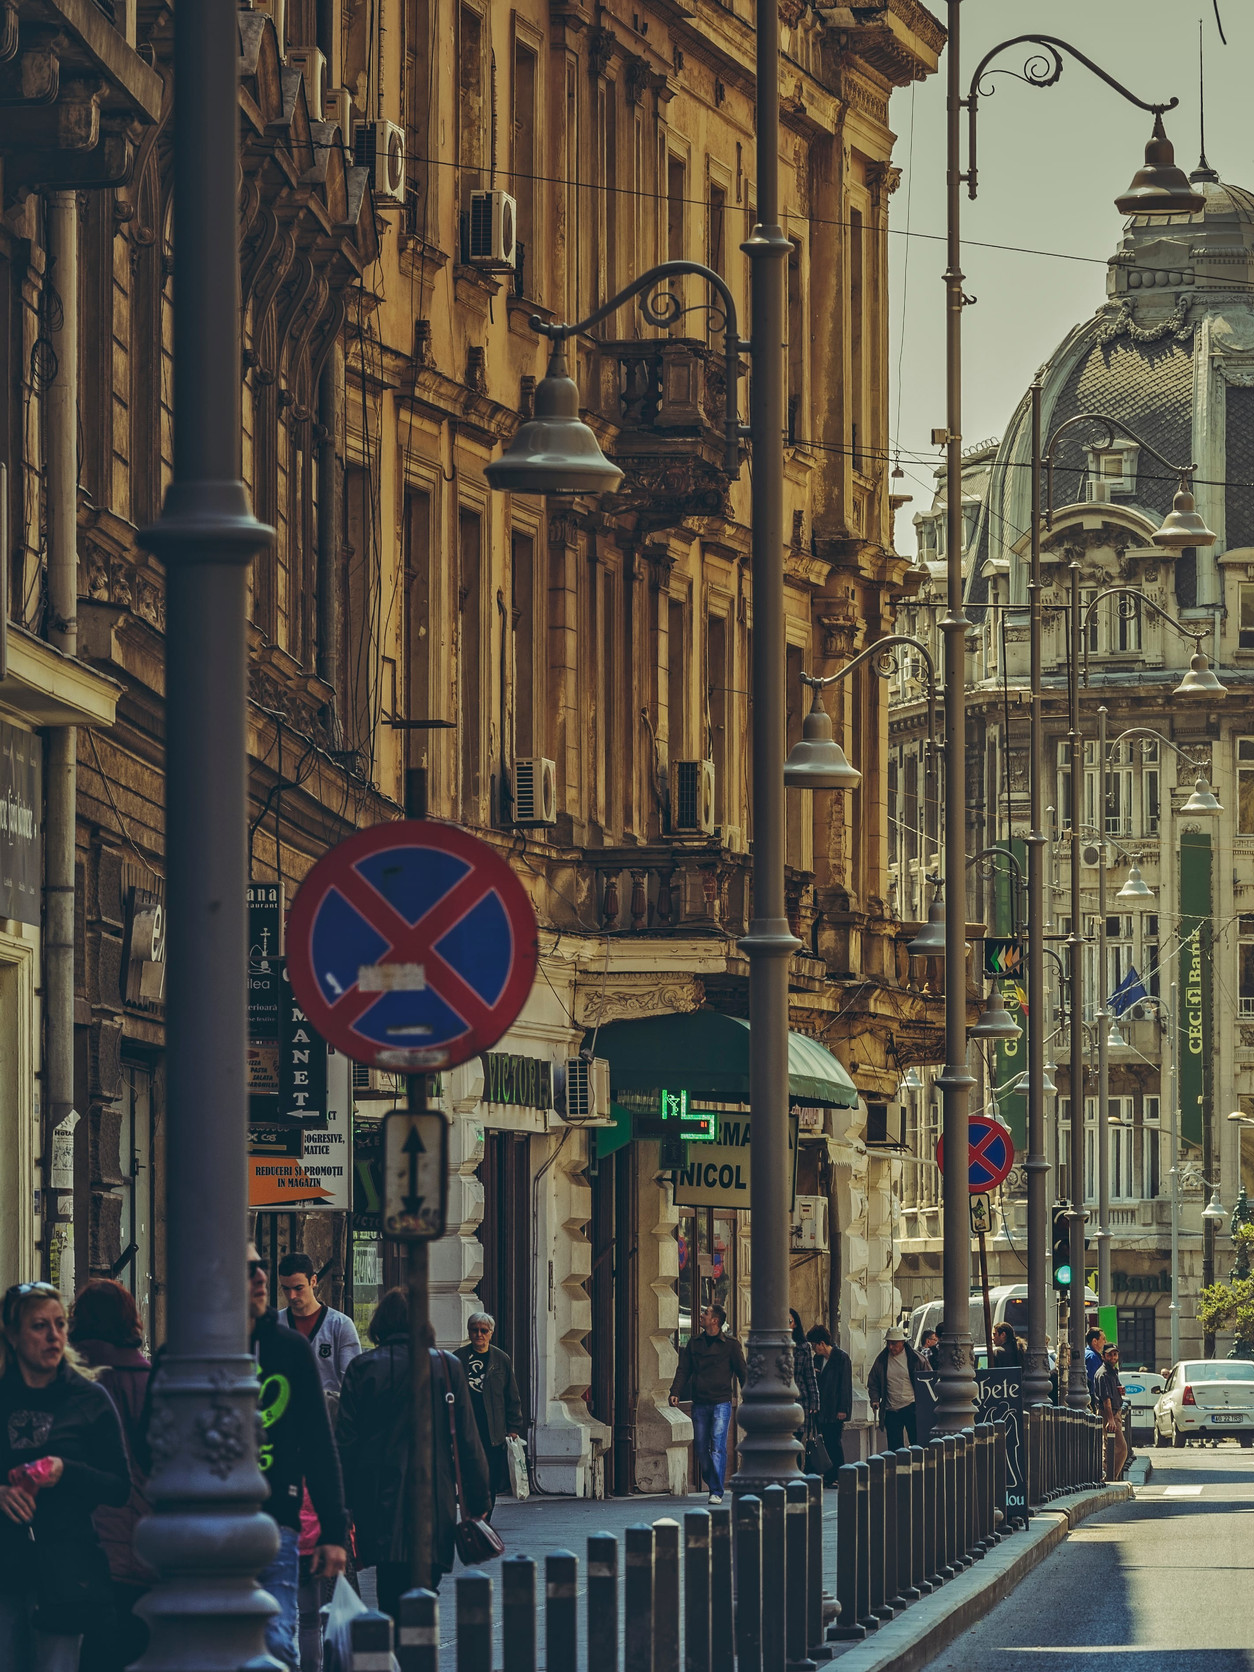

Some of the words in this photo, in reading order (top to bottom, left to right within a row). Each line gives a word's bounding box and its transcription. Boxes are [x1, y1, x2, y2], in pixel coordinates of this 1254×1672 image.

[1188, 929, 1202, 983] Bank
[1188, 1011, 1203, 1055] CEC
[304, 1134, 345, 1145] OGRESIVE,
[255, 1166, 292, 1176] REDUCERI
[277, 1178, 286, 1187] IN
[287, 1178, 321, 1188] MAGAZIN
